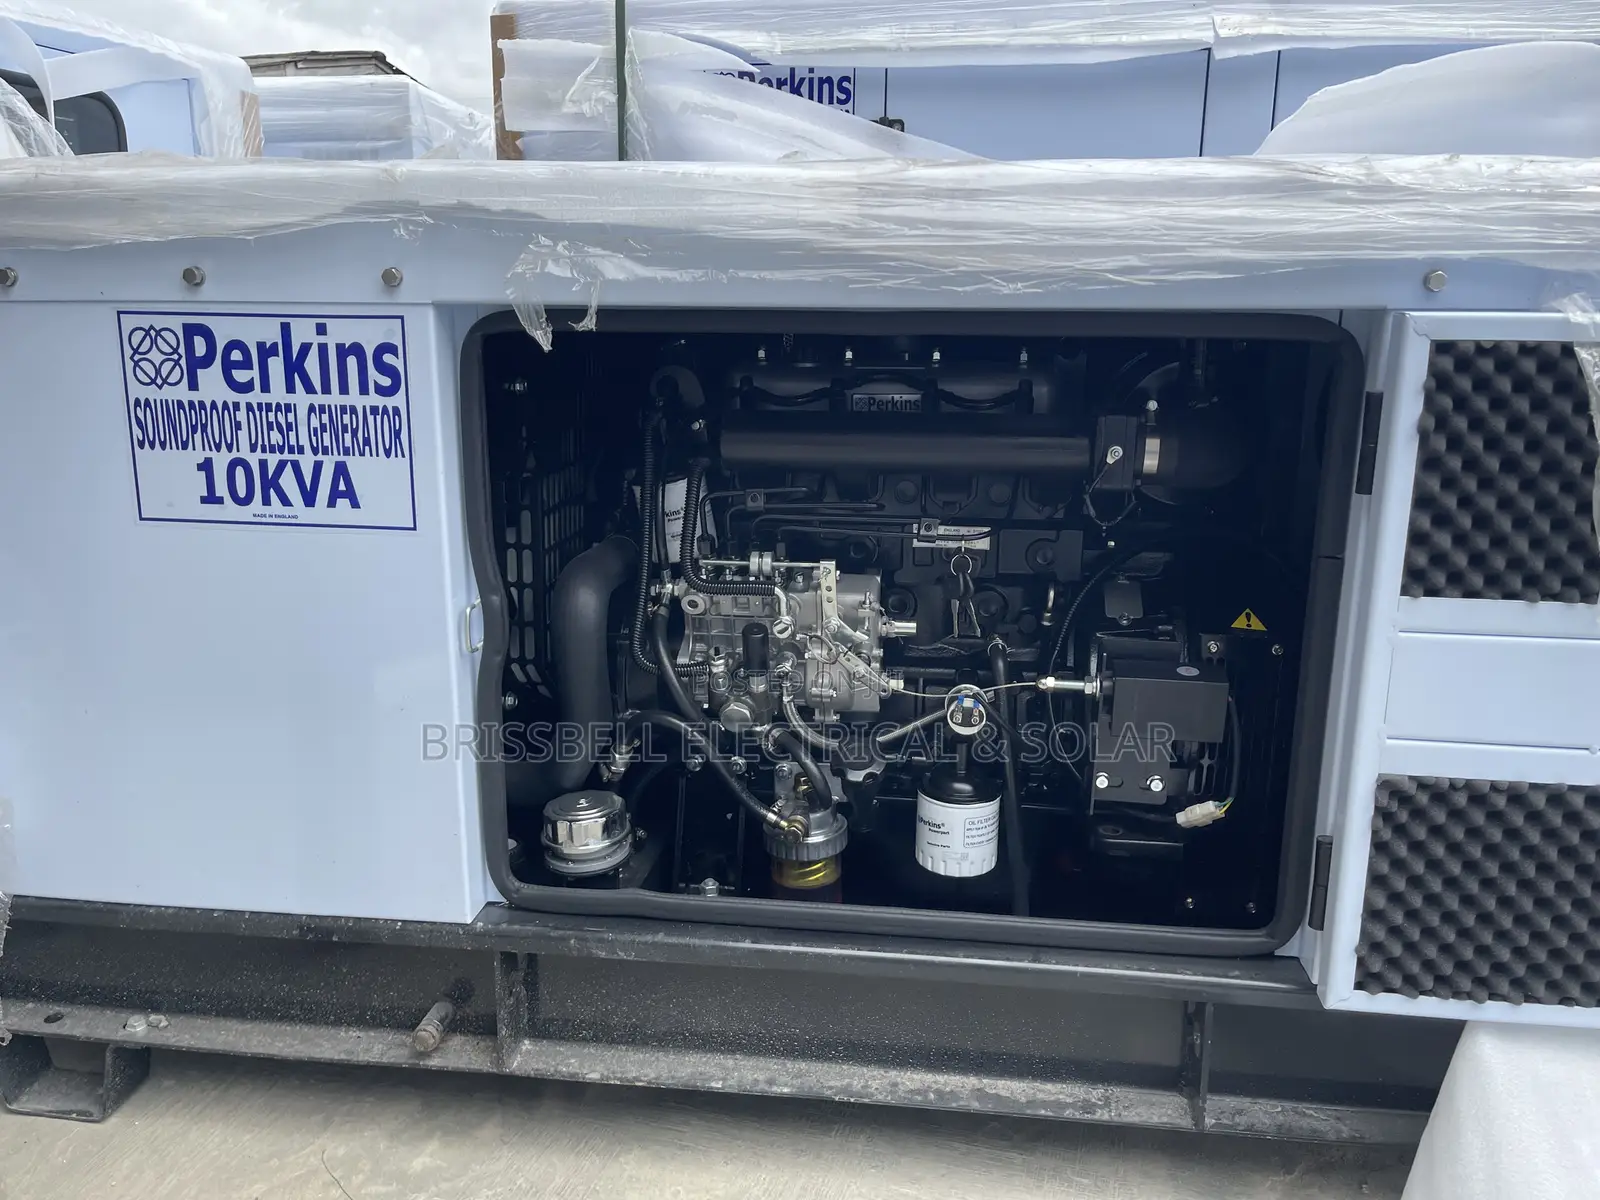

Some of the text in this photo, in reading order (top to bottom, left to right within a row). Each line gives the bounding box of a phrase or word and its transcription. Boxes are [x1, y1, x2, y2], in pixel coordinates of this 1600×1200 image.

[182, 322, 402, 397] Perkins
[134, 397, 406, 459] SOUNDPROOF DIESEL GENERATOR
[869, 396, 920, 411] Perkins
[197, 457, 361, 509] 10KVA
